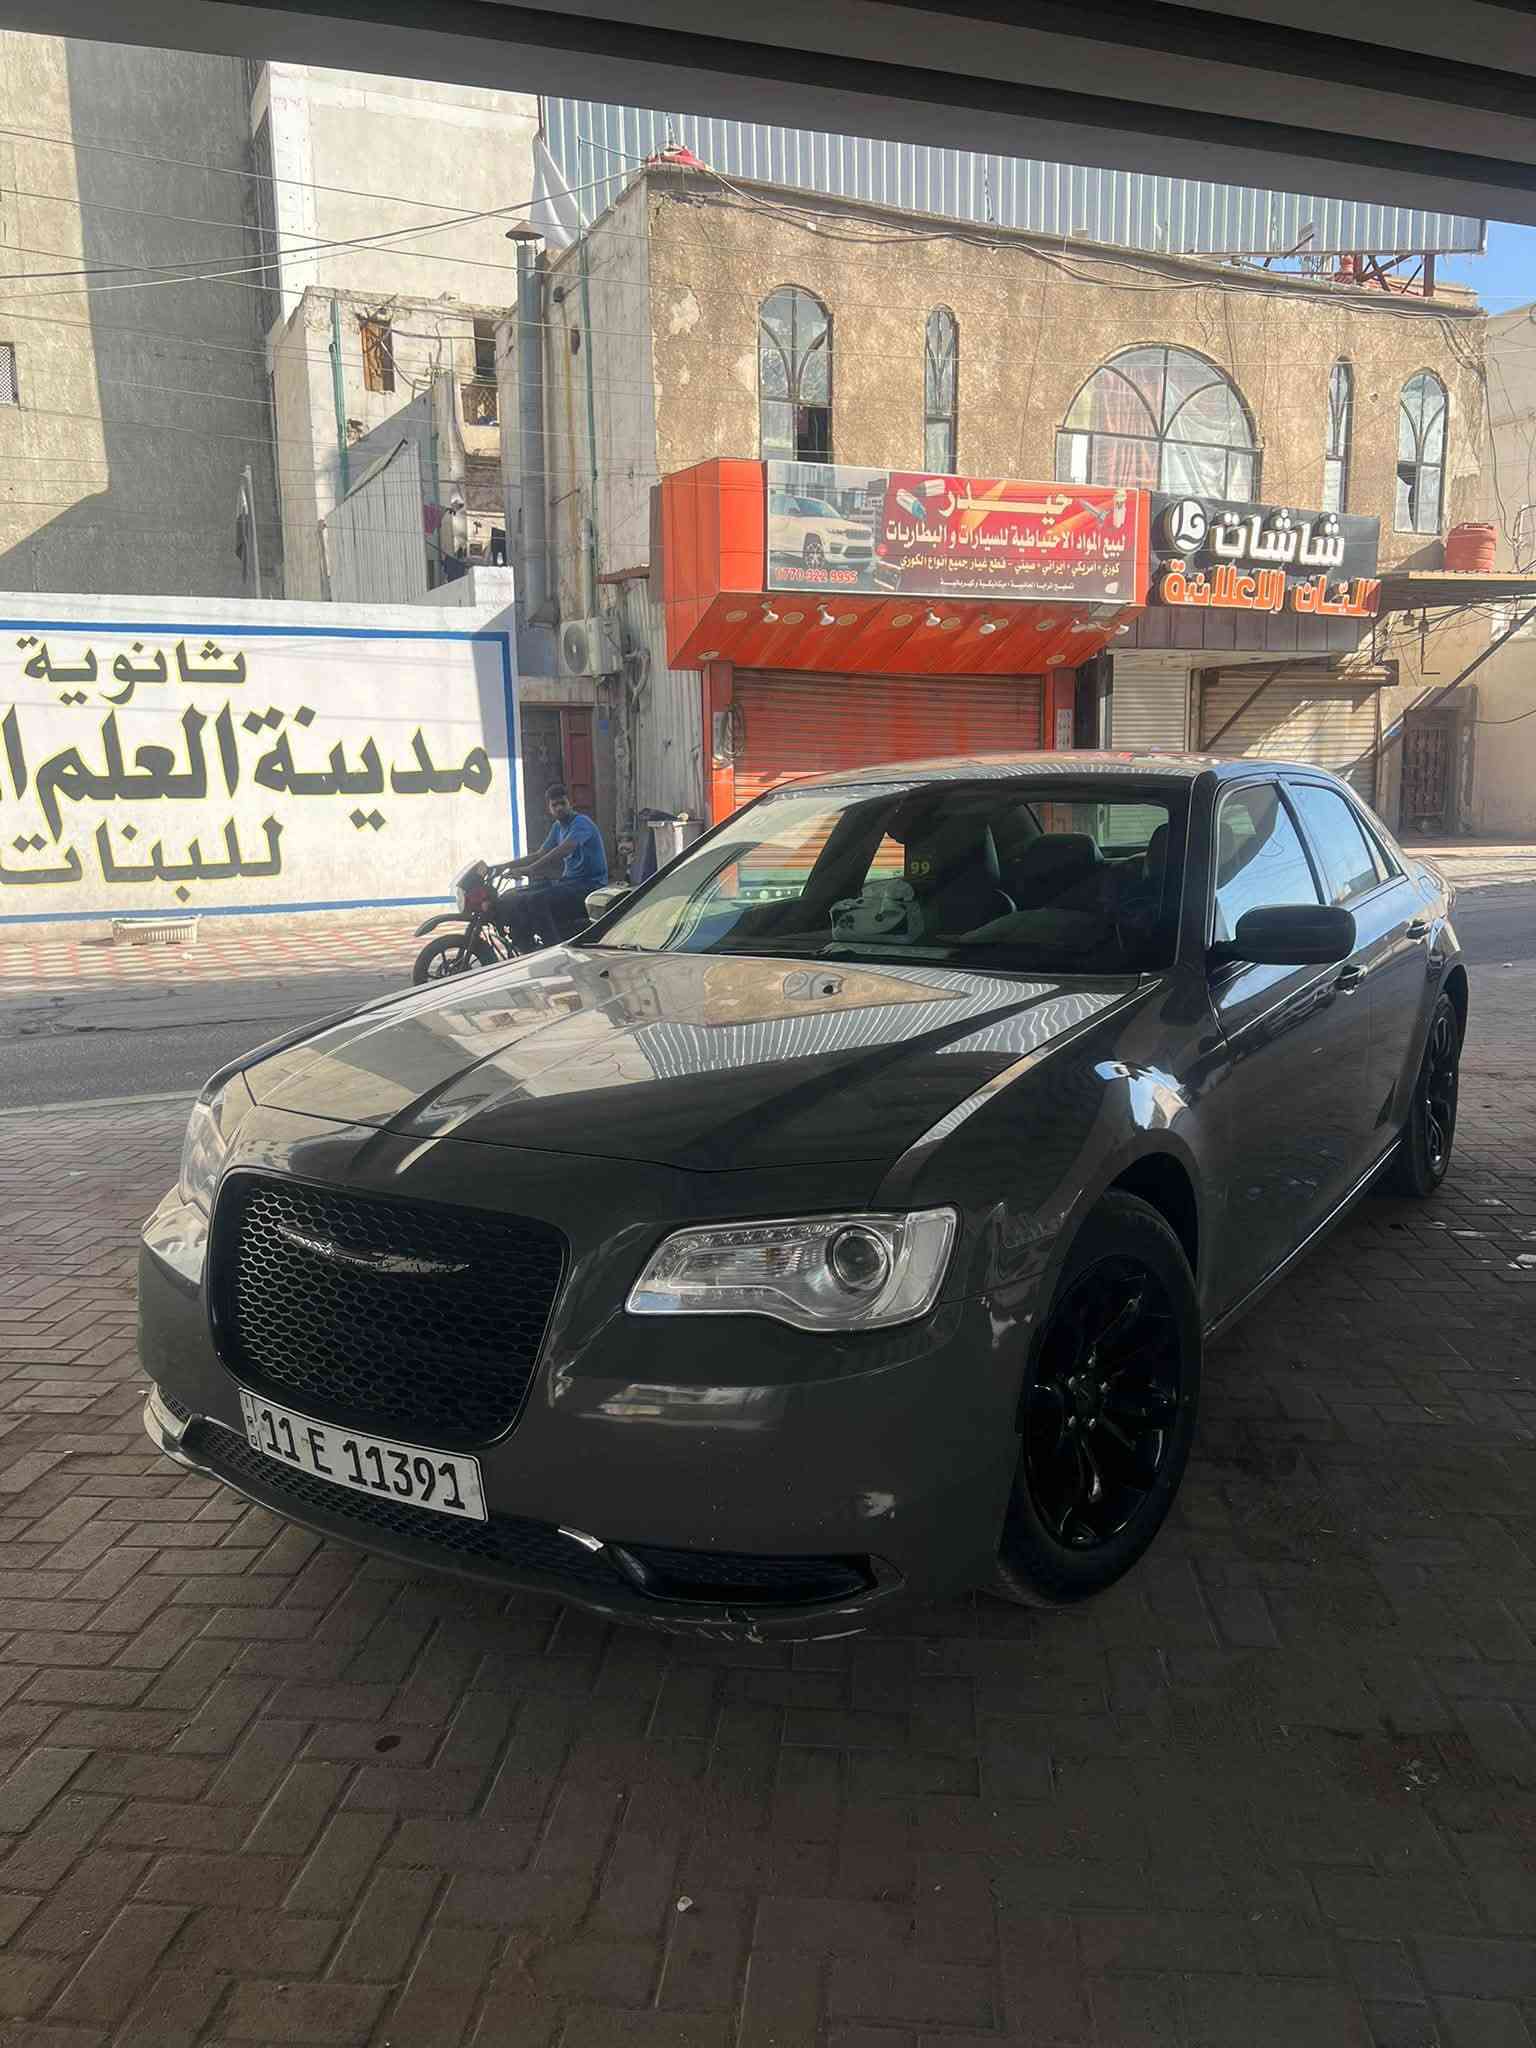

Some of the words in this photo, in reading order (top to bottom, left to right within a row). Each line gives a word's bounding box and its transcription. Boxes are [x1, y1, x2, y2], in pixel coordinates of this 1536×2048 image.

[958, 525, 1009, 551] للسيارات
[1076, 531, 1101, 555] المواد
[1102, 534, 1125, 559] لبيع
[1214, 507, 1345, 567] شاشات
[16, 635, 246, 704] ثانوية
[35, 699, 240, 842] العلم
[242, 704, 494, 832] مدينة
[0, 815, 284, 902] للبنات
[261, 1408, 301, 1463] 11
[306, 1426, 333, 1475] E
[342, 1439, 466, 1510] 11391
